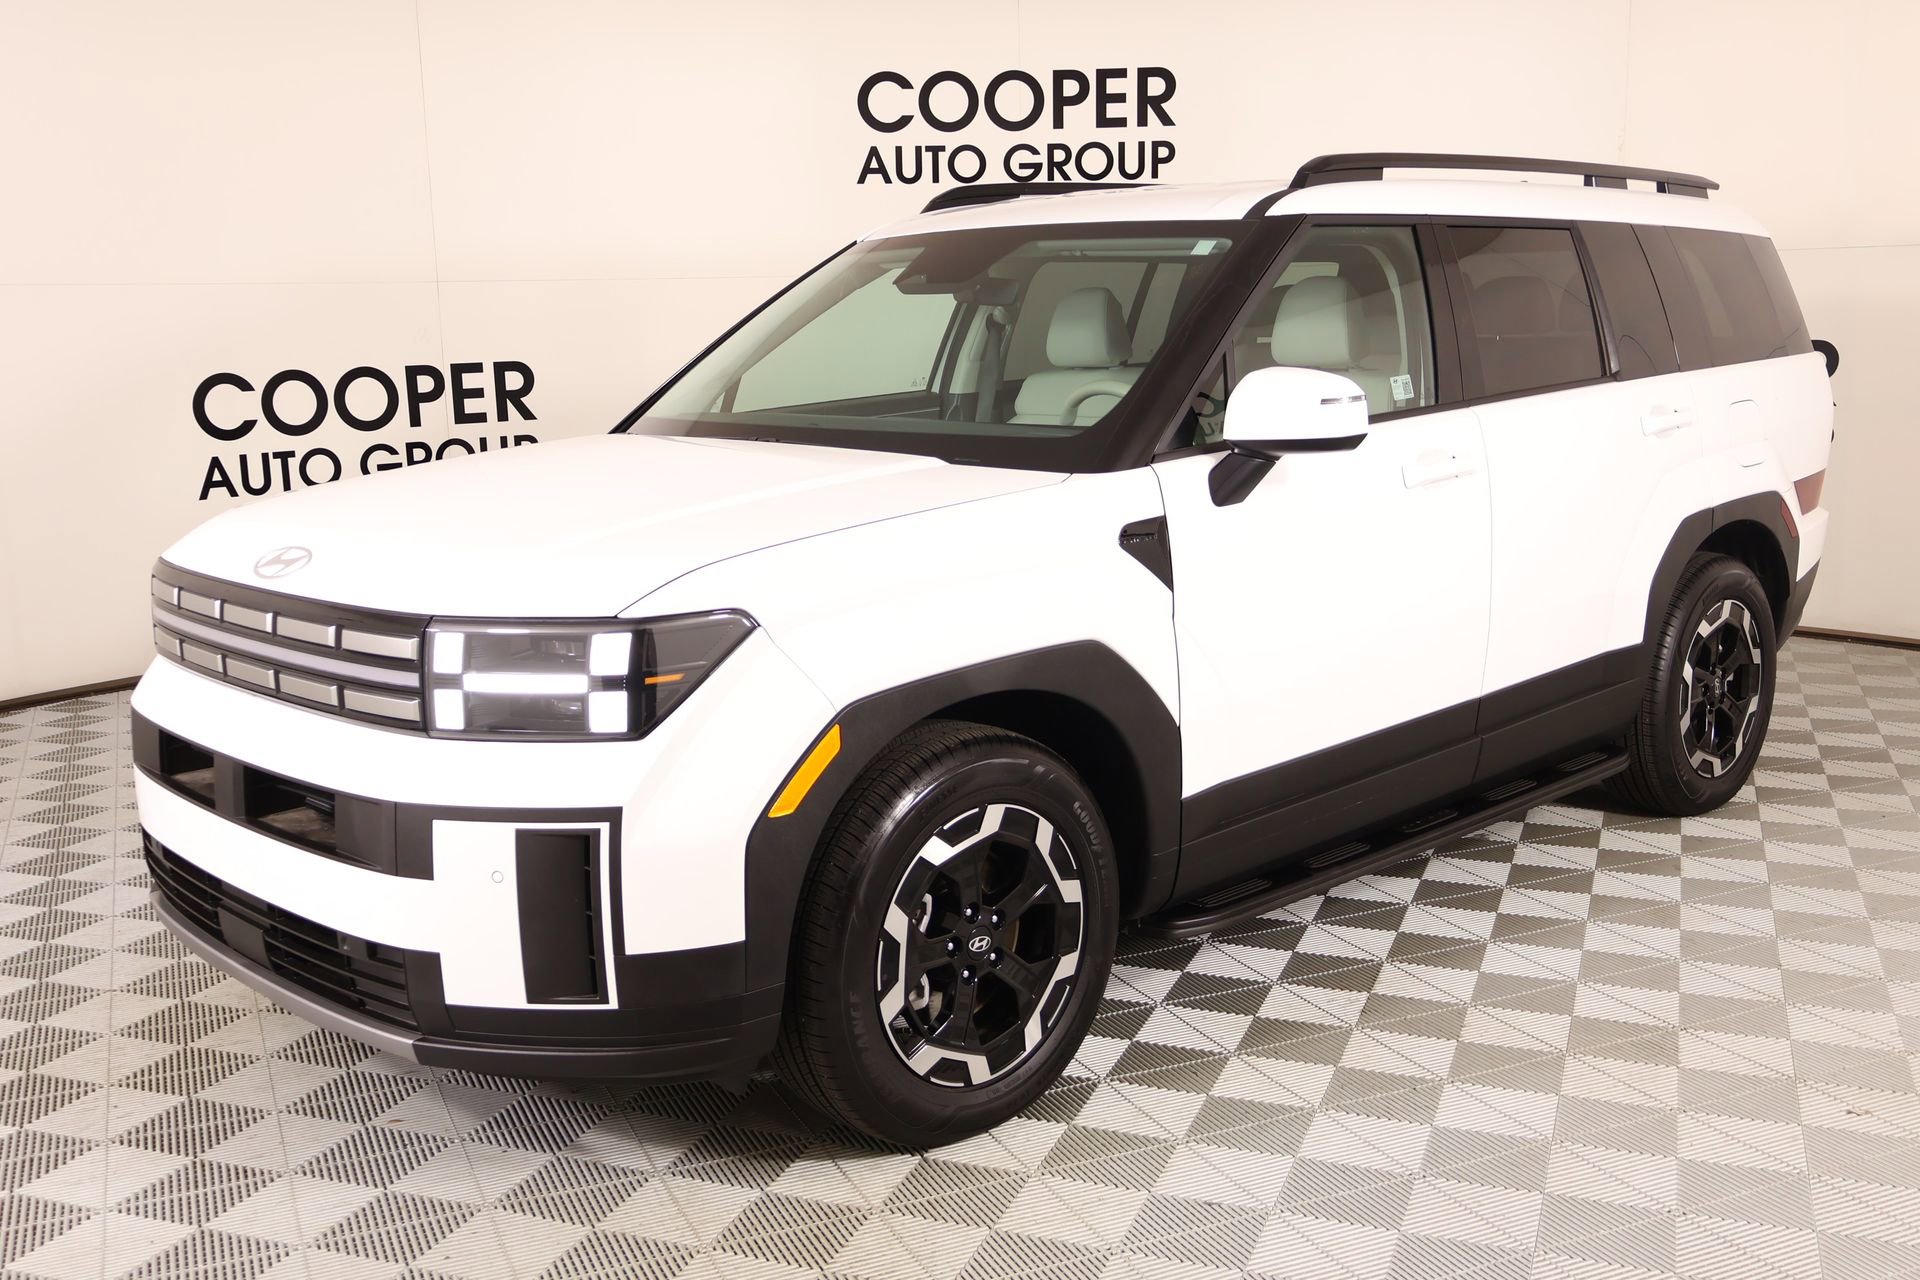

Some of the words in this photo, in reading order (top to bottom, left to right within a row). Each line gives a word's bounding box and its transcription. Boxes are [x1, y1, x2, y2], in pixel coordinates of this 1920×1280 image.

[858, 67, 1176, 133] COOPER
[857, 143, 987, 184] AUTO
[1003, 140, 1176, 182] GROUP
[192, 361, 538, 441] COOPER
[199, 447, 342, 500] AUTO
